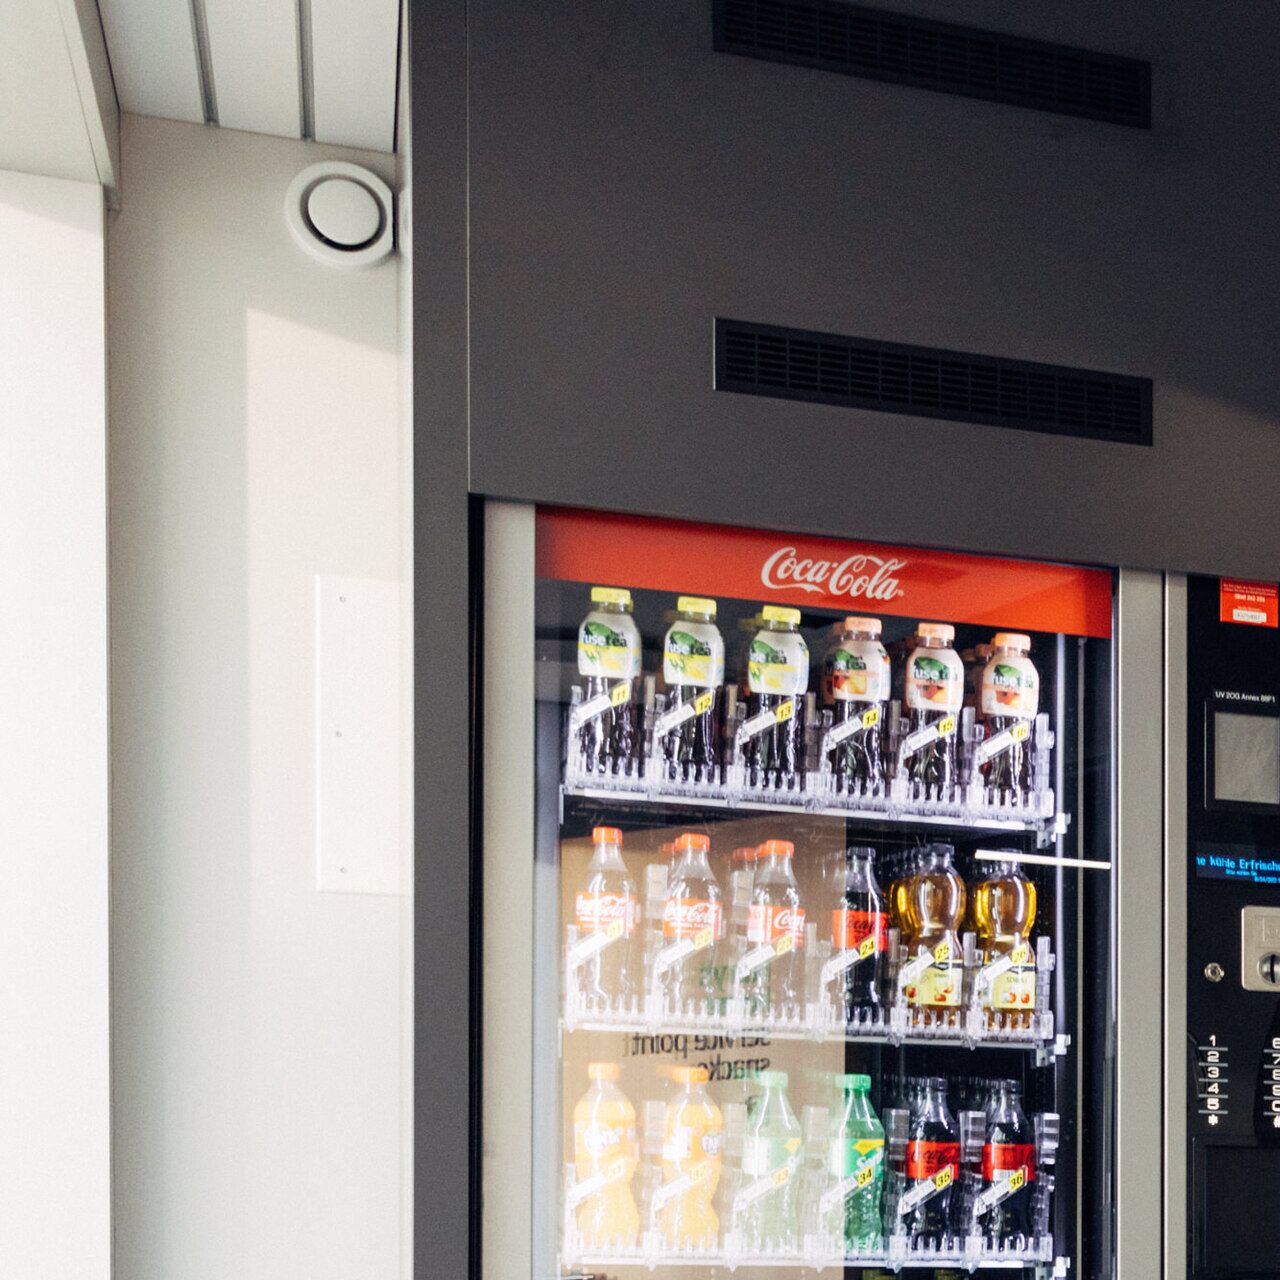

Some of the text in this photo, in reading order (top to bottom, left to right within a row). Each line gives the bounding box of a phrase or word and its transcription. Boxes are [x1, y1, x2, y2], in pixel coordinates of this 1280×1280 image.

[760, 546, 907, 601] Coca-Cola
[1209, 1034, 1216, 1047] 1
[1207, 1051, 1219, 1062] 2
[1207, 1066, 1219, 1078] 3
[1207, 1082, 1219, 1094] 4
[1207, 1098, 1219, 1110] 5
